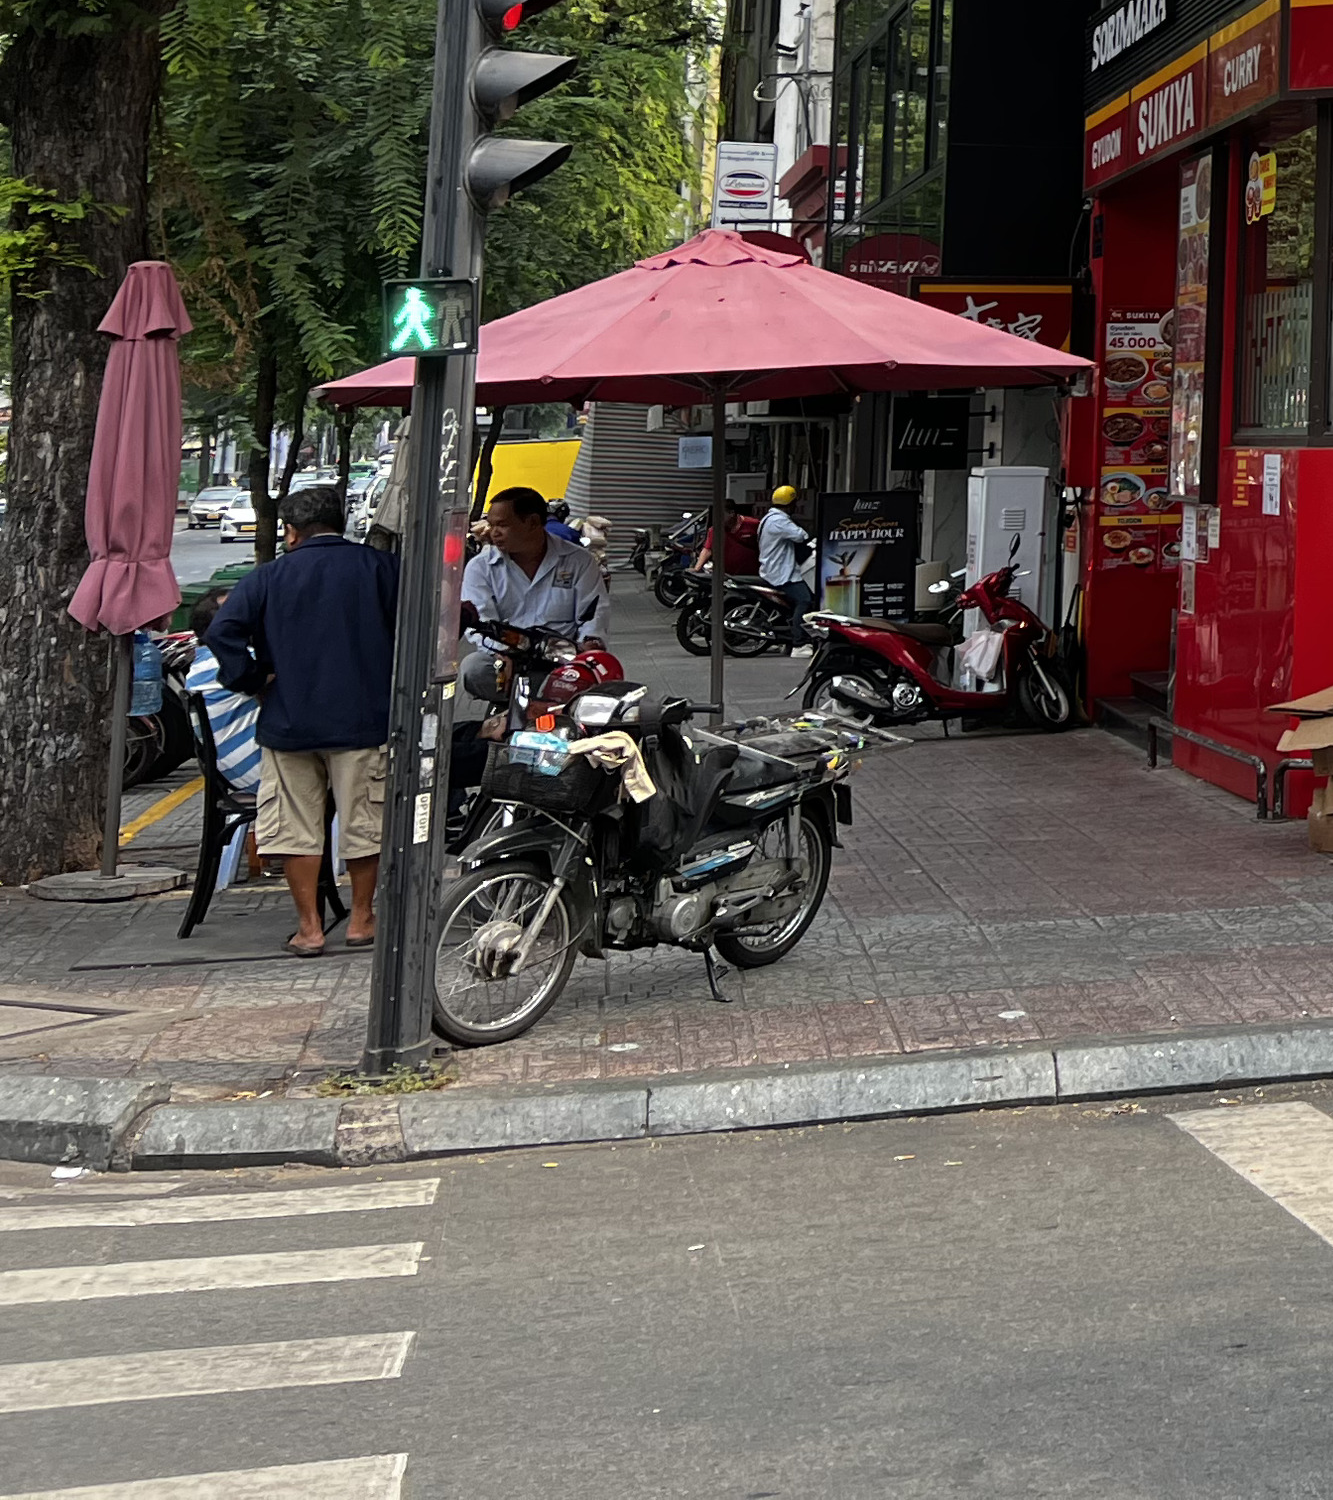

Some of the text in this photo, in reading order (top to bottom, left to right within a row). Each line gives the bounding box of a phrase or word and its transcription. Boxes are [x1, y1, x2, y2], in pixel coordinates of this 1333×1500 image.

[1223, 43, 1262, 97] CURRY
[1138, 72, 1195, 155] SUKIYA
[1092, 127, 1122, 169] GYUDON
[1126, 311, 1160, 320] SUKIYA
[829, 528, 905, 541] HAPPY HOUR
